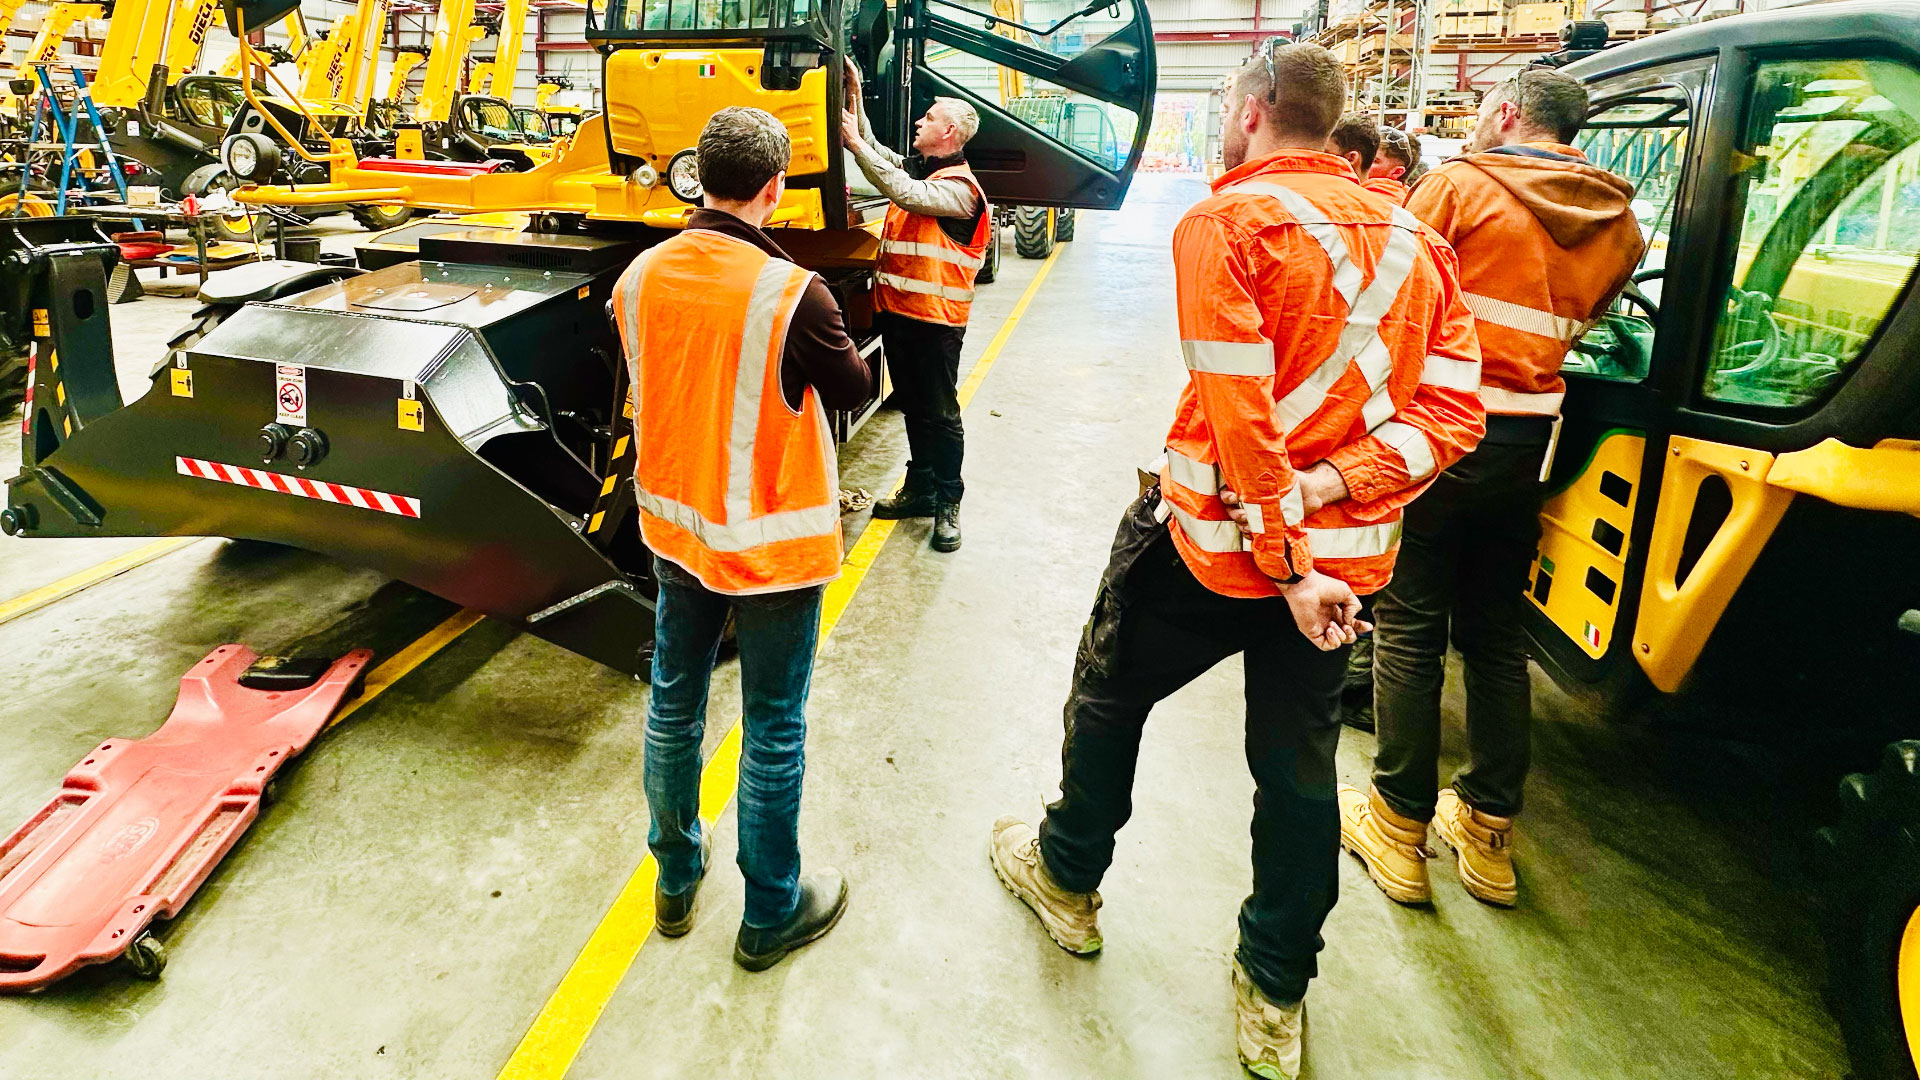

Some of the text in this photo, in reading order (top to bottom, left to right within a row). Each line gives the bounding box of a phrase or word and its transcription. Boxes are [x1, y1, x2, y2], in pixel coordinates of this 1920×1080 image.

[188, 2, 213, 46] DIECI
[326, 51, 343, 82] DIECI
[541, 151, 551, 159] DIE
